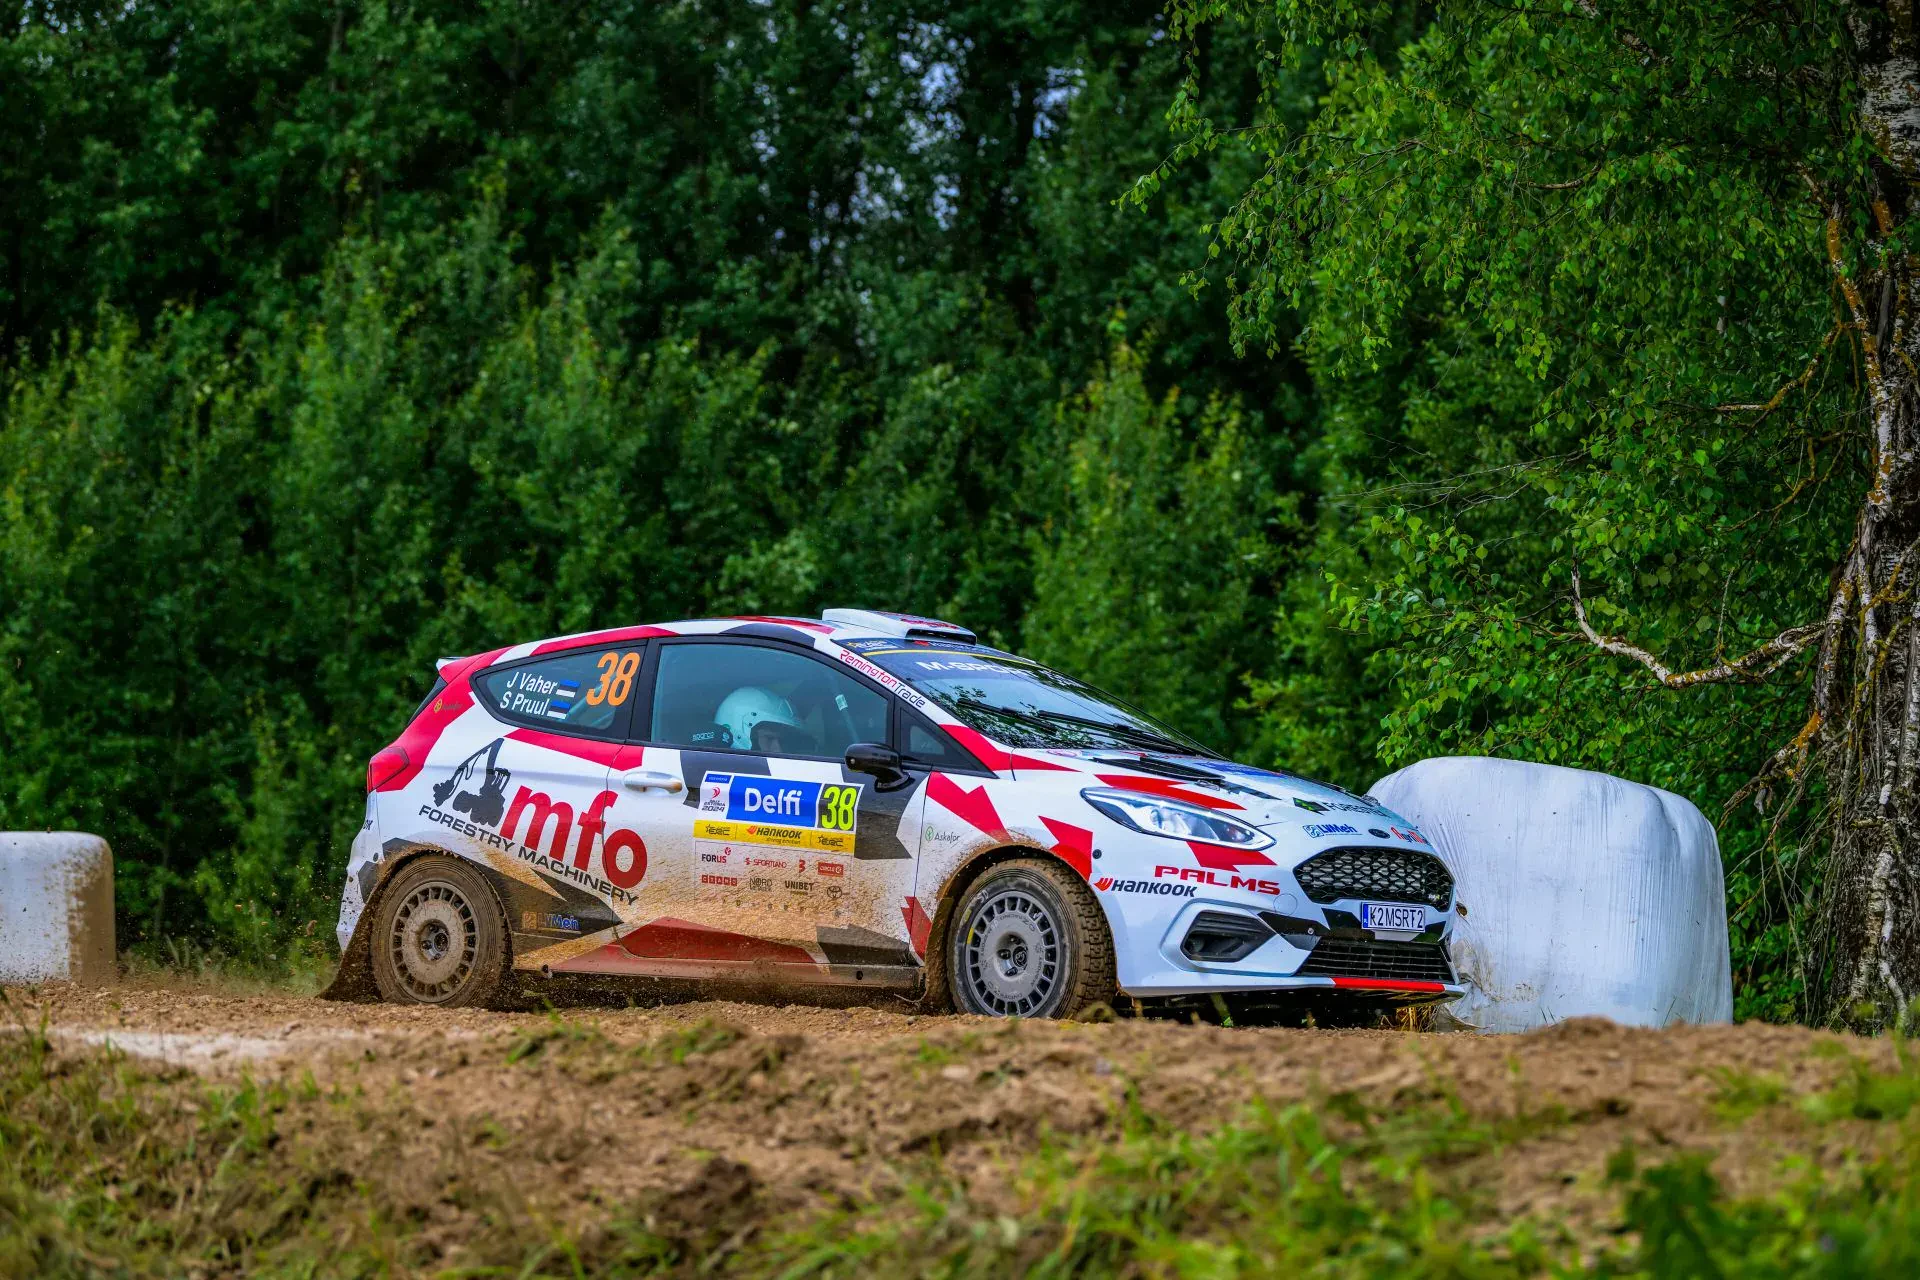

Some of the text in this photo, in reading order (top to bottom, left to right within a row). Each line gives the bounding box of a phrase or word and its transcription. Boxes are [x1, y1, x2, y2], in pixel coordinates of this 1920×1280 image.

[506, 671, 558, 695] J Vaher
[586, 652, 641, 706] 38
[499, 691, 550, 716] S Pruul
[701, 805, 725, 813] 2024
[744, 787, 804, 816] Delfi
[821, 786, 857, 831] 38
[500, 785, 648, 890] mfo
[418, 804, 639, 906] FORESTRY MACHINERY
[701, 853, 727, 864] FORUS
[784, 880, 815, 892] UNIBET
[1154, 865, 1281, 896] PALMS
